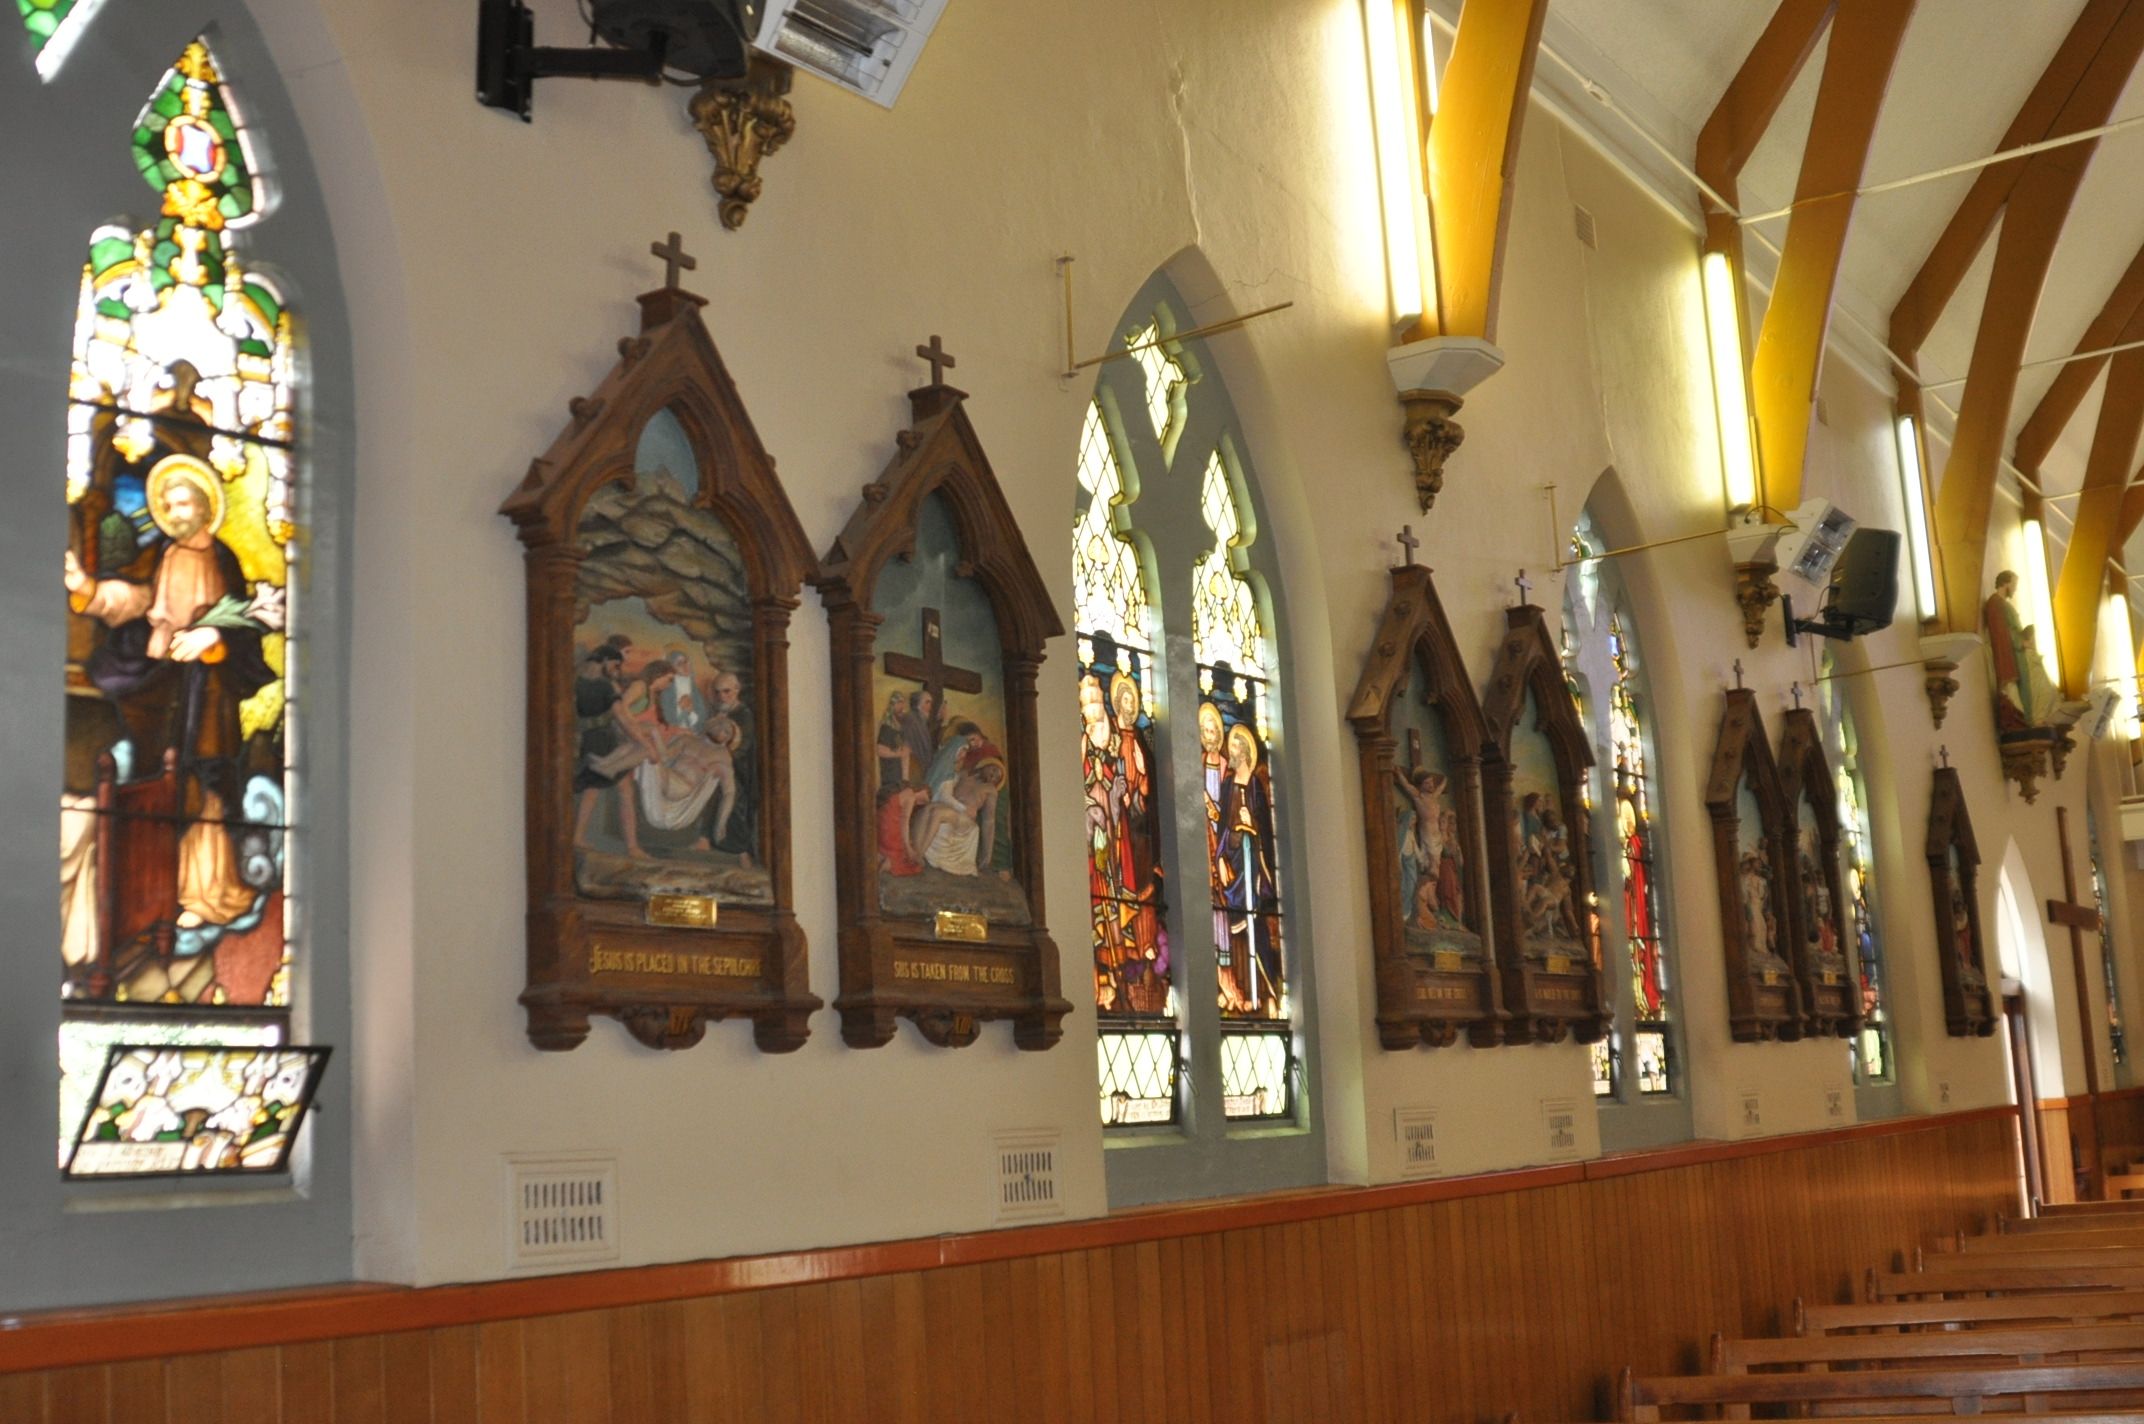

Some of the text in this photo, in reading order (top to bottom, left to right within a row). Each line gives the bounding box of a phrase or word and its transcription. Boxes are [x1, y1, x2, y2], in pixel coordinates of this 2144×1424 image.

[589, 945, 622, 975] JESUS
[624, 951, 634, 972] IS
[636, 952, 674, 974] PLACED
[677, 954, 688, 975] IN
[690, 955, 712, 975] THE
[894, 960, 1014, 985] SUS IS TAKEN FROM THE CROSS
